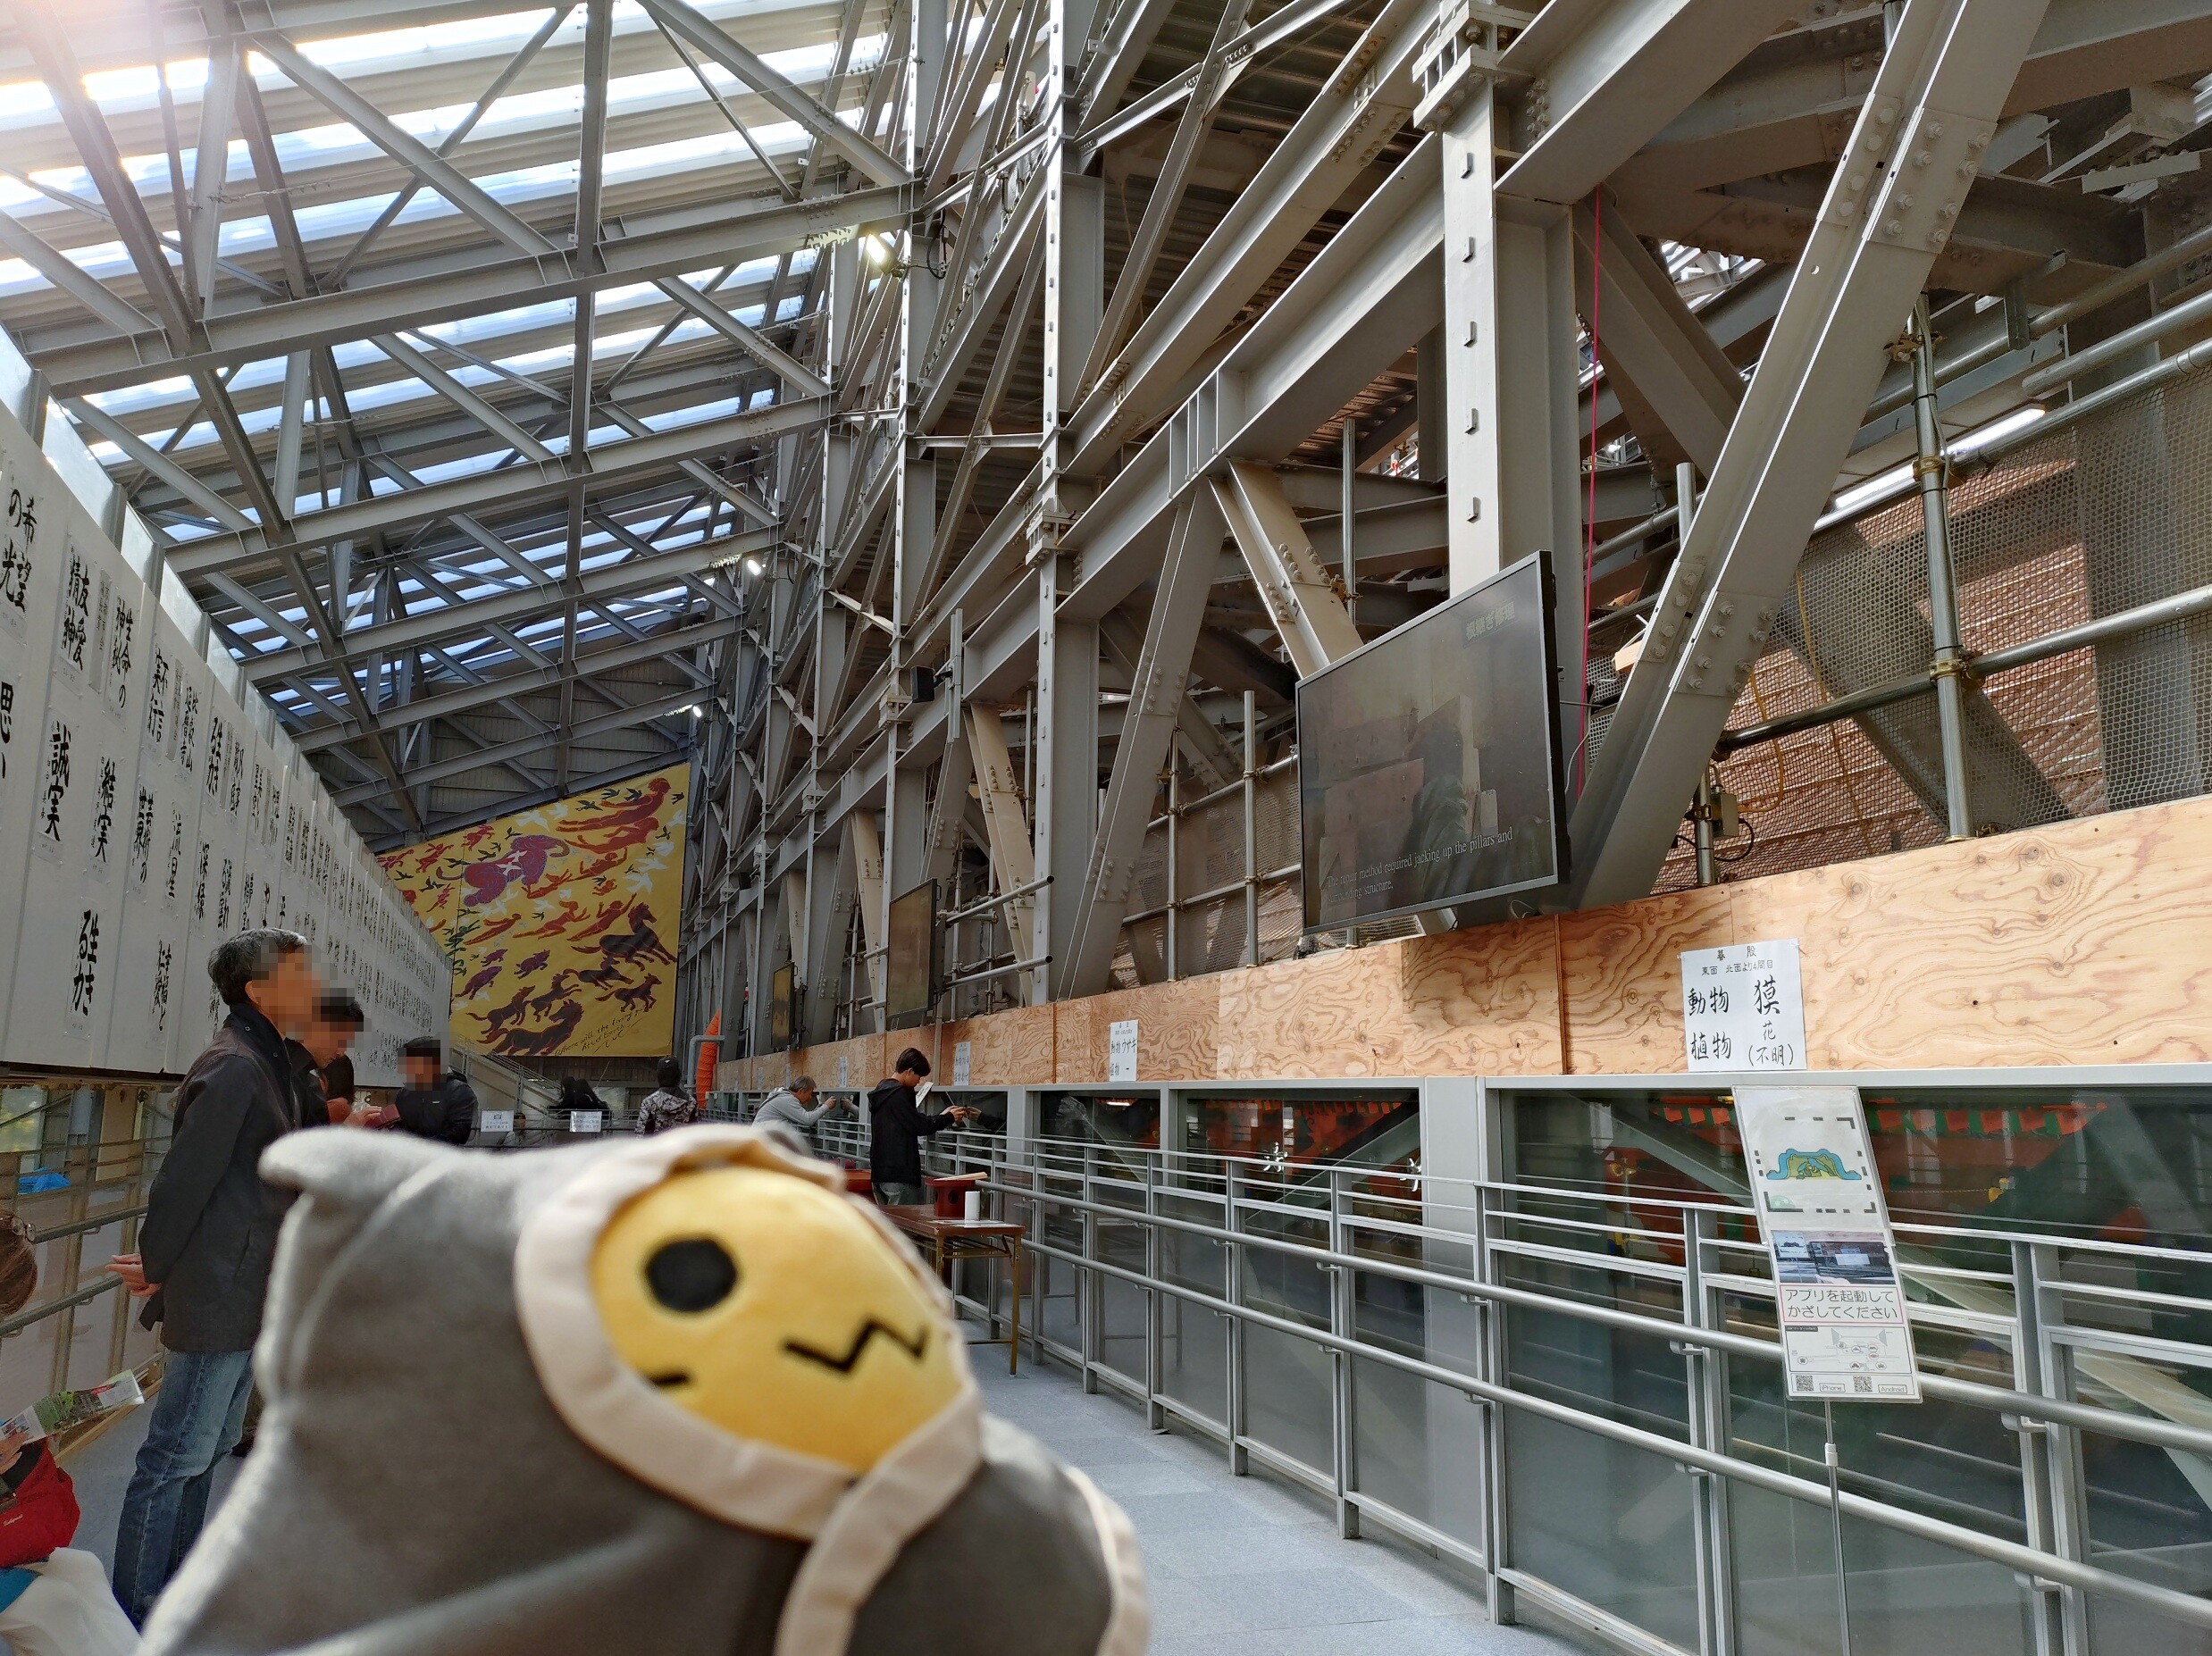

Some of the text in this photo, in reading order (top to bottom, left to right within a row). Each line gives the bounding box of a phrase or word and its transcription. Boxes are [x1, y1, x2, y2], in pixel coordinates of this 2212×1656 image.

[44, 721, 71, 842] 誠実
[95, 757, 116, 863] 結実
[1359, 862, 1383, 880] method
[1385, 854, 1412, 873] required
[1413, 849, 1440, 868] jacking
[1443, 847, 1453, 859] up
[1455, 841, 1468, 855] the
[1470, 834, 1496, 854] pillars
[1498, 826, 1513, 844] and
[1687, 984, 1730, 1016] 動物
[597, 1024, 609, 1033] the
[1763, 1020, 1777, 1041] 花
[1689, 1030, 1795, 1067] 植物 (不明)
[1785, 1289, 1895, 1303] アプリを起動して
[1787, 1305, 1898, 1320] かざしてください
[1881, 1384, 1906, 1393] Android
